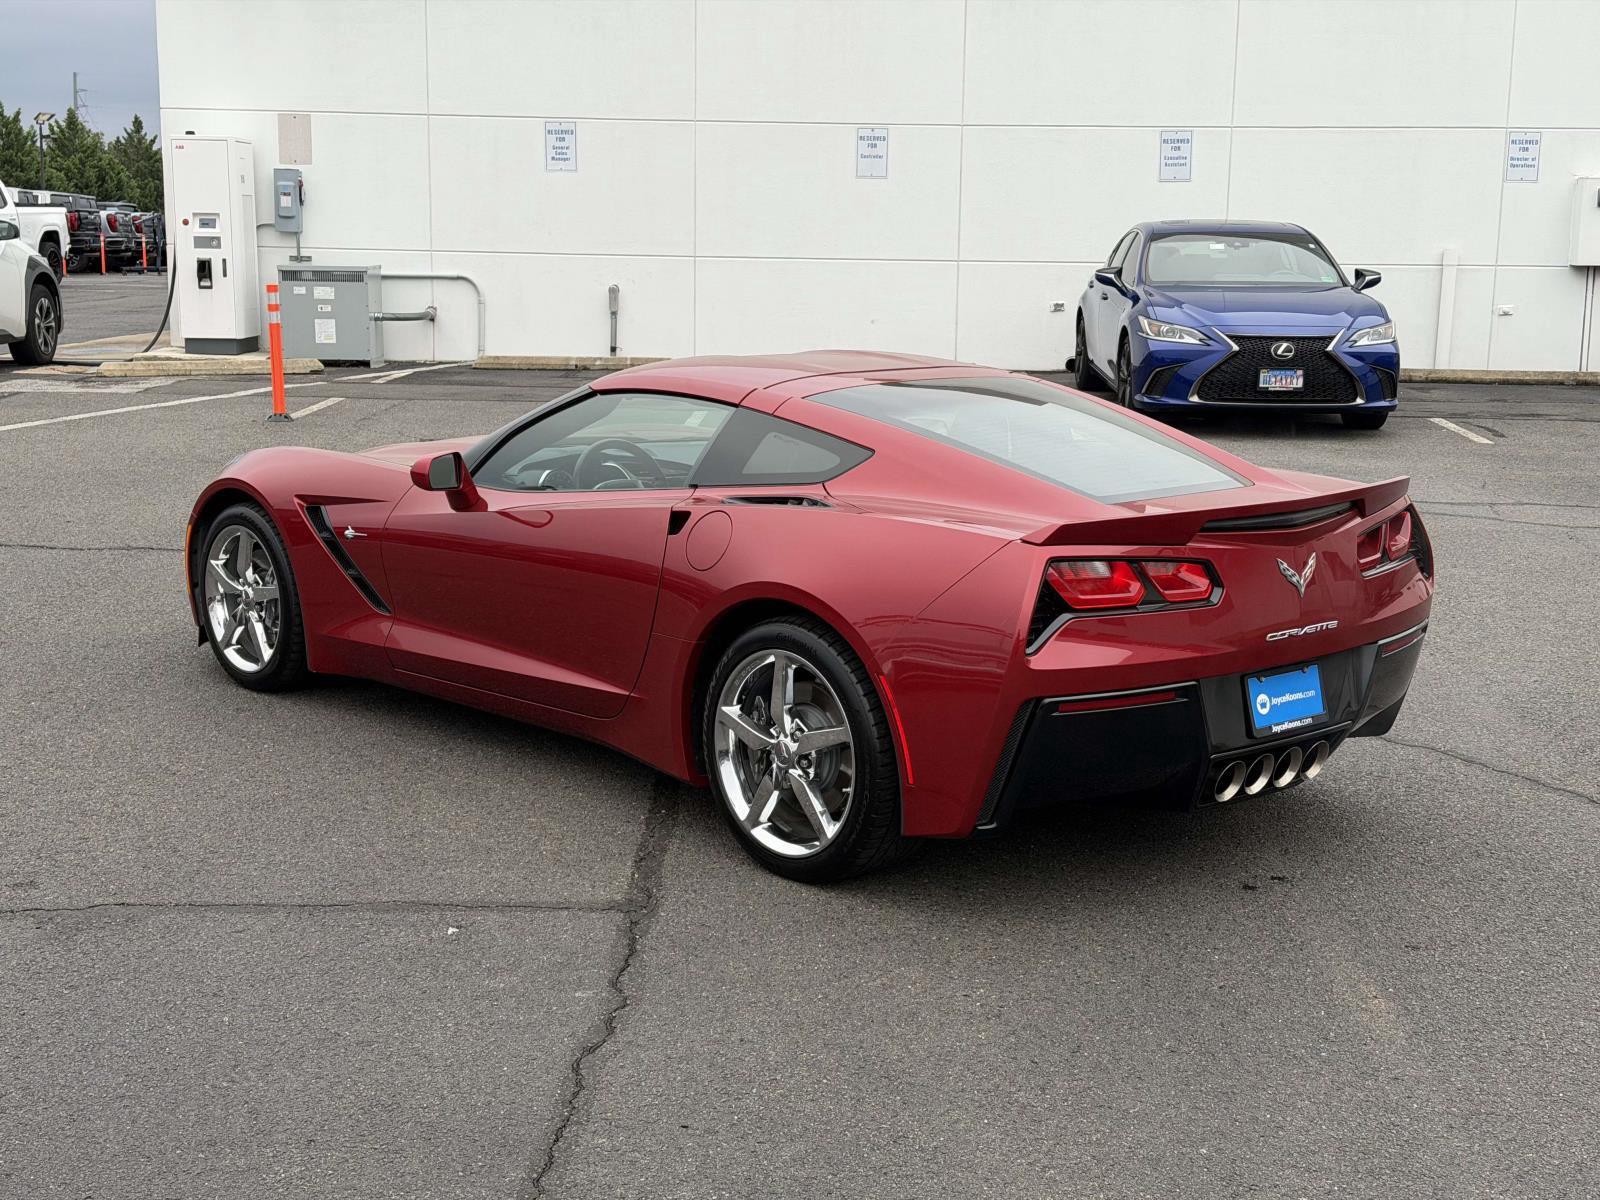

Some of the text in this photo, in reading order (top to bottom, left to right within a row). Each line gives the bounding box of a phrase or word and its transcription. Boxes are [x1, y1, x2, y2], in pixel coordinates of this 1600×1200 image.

[1266, 620, 1338, 641] CORVETTE
[1271, 689, 1316, 706] JoyceKoons.com
[1271, 717, 1313, 733] JoyceKoons.com
